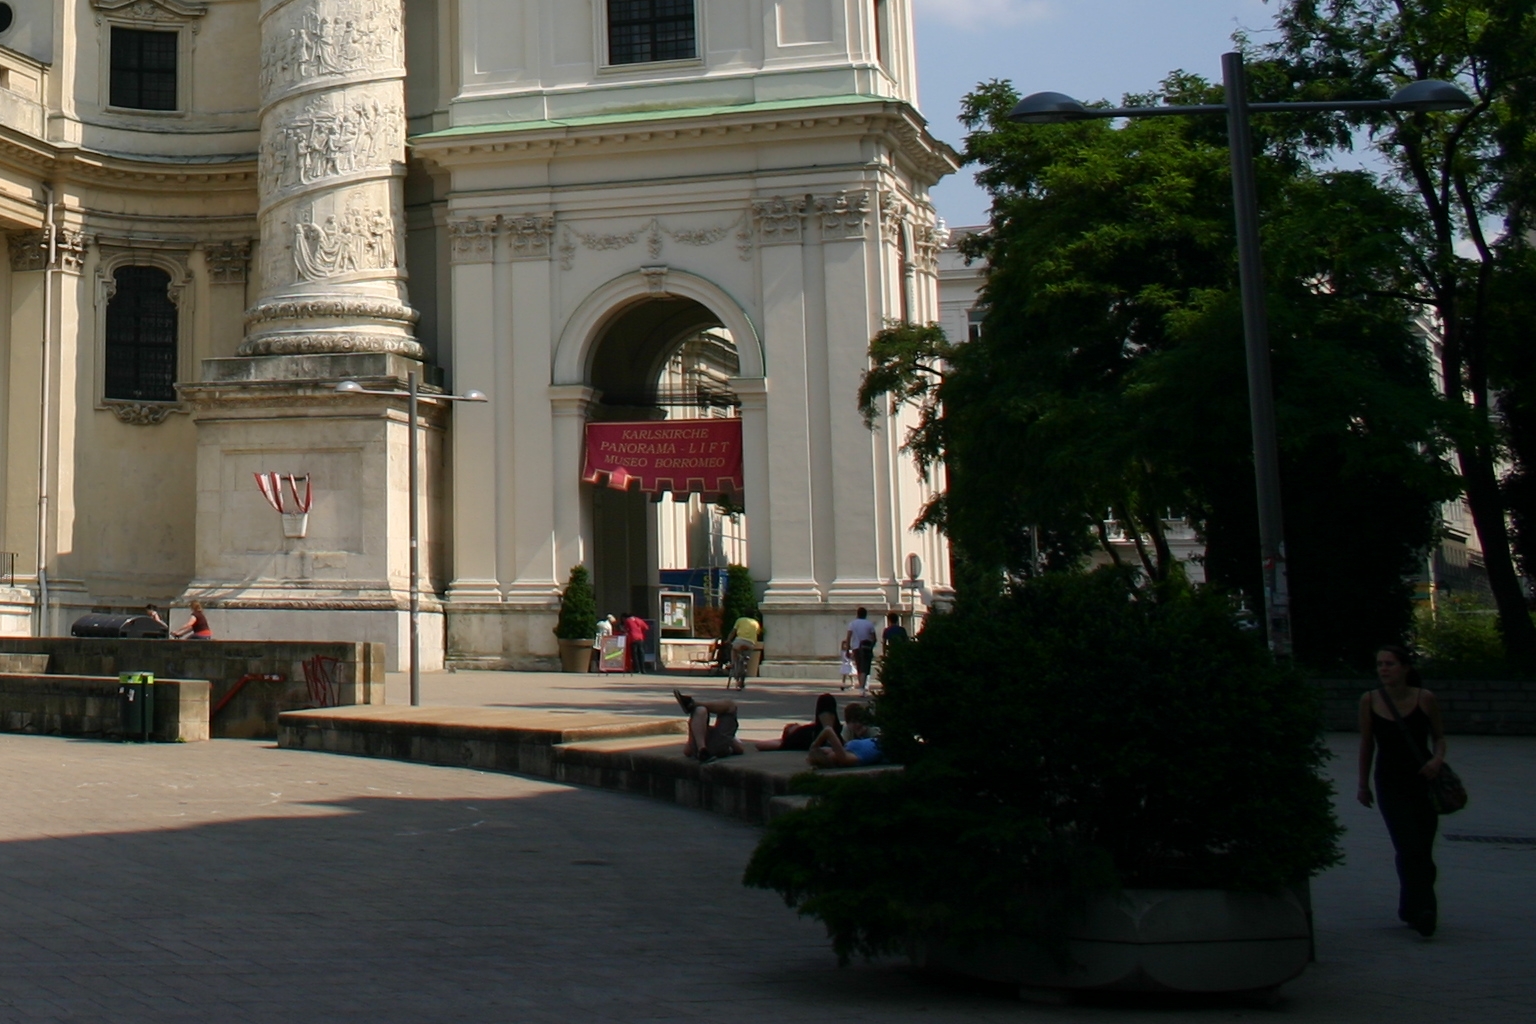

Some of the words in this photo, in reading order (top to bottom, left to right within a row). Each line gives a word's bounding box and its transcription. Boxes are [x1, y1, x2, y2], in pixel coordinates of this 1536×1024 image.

[622, 428, 709, 440] KARLSKIRCHE
[600, 441, 676, 454] PANORAMA
[604, 455, 648, 467] MUSEO
[655, 457, 725, 468] BORROMEO
